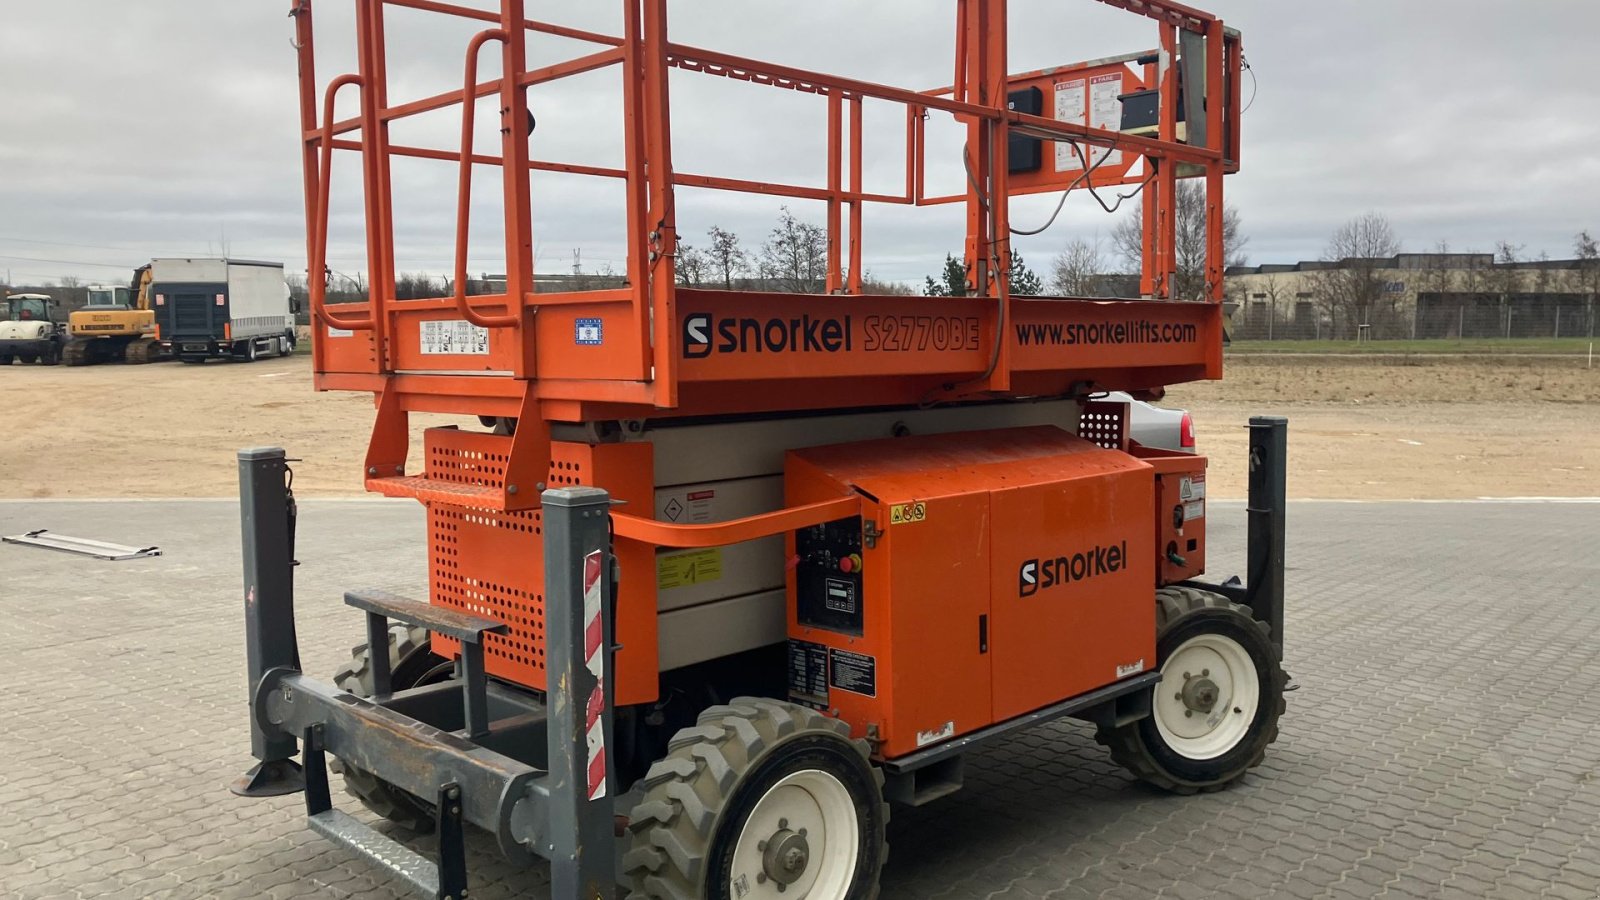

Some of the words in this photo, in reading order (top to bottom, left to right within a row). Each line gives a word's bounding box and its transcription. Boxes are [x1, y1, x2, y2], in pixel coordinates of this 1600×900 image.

[718, 314, 851, 353] snorkel
[864, 315, 979, 352] S2770BE
[1015, 320, 1197, 346] www.snorkellifts.com
[1041, 540, 1127, 588] snorkel
